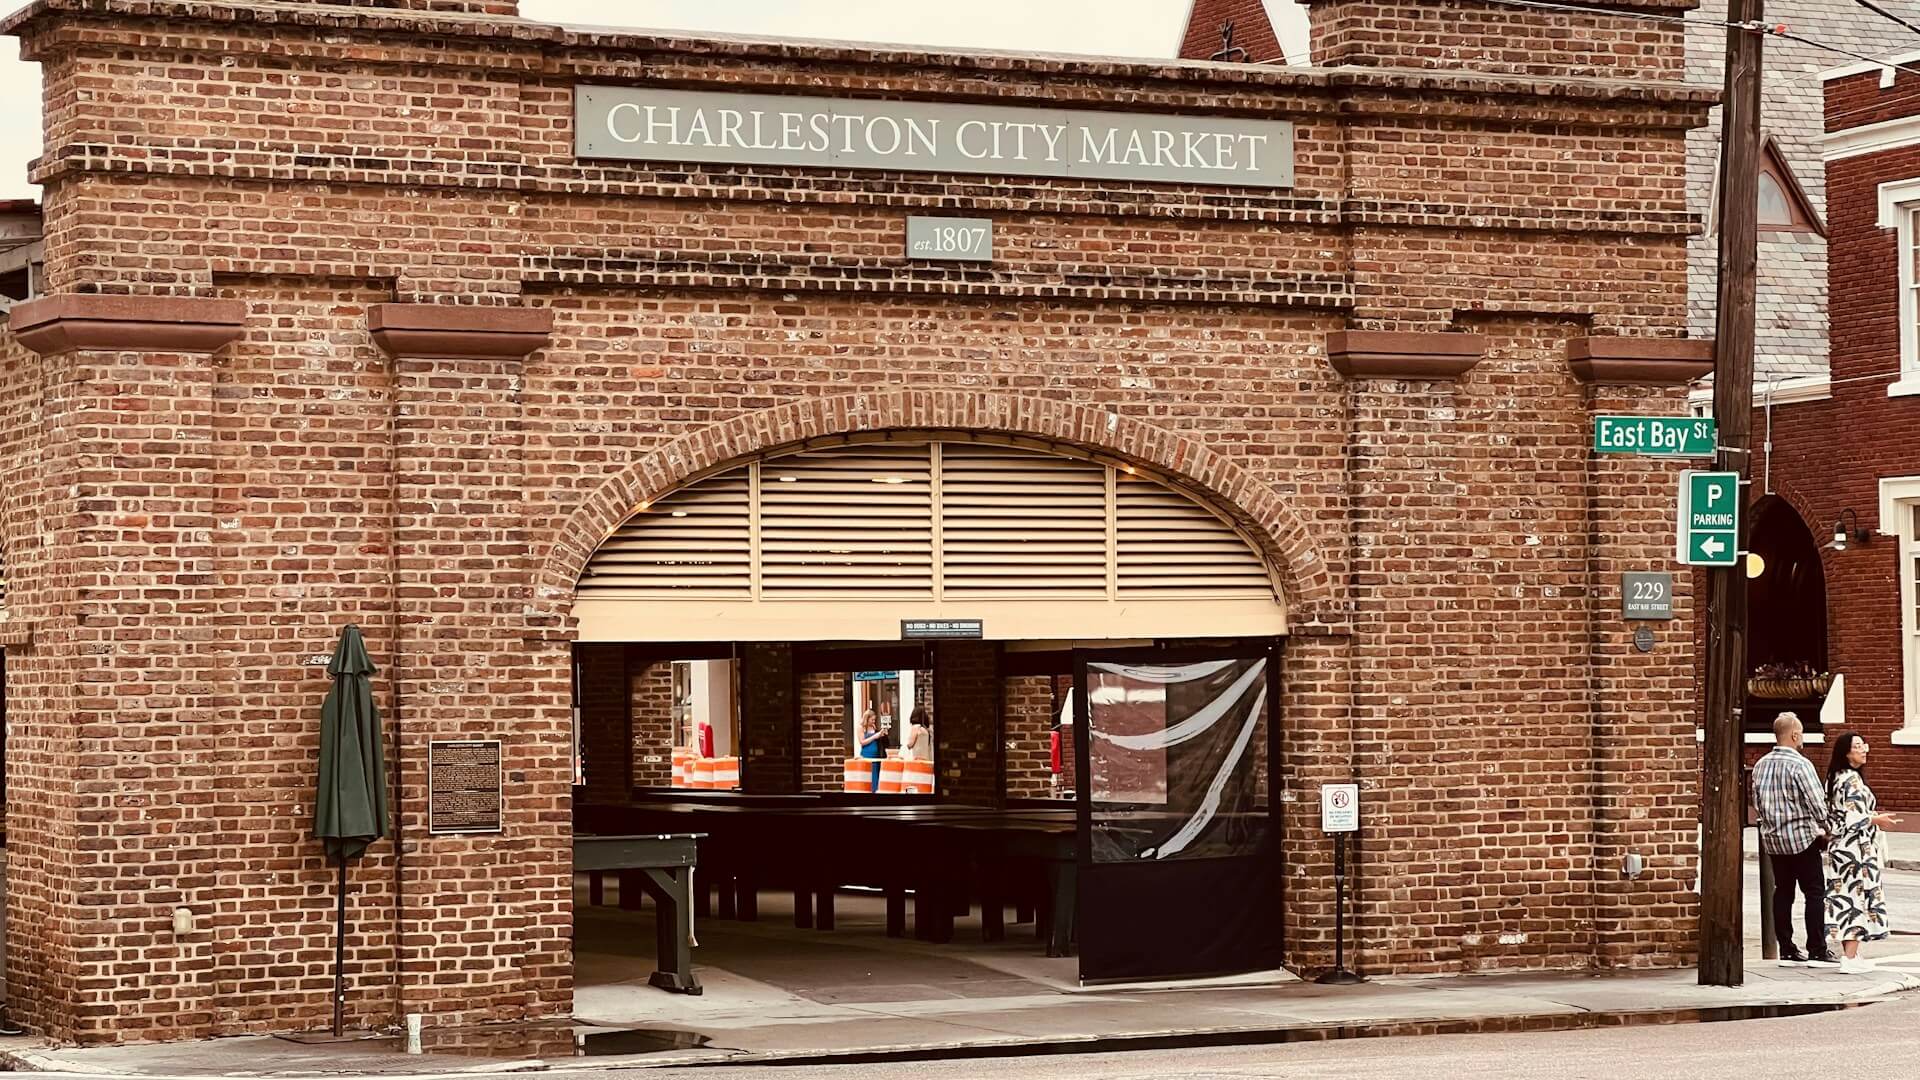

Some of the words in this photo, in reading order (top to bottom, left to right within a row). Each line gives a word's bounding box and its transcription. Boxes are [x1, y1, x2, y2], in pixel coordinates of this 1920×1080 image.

[607, 103, 940, 156] CHARLESTON
[956, 121, 1066, 162] CITY
[1079, 126, 1267, 171] MARKET
[933, 227, 986, 254] 1807
[1600, 421, 1645, 447] East
[1651, 421, 1689, 452] Bay
[1693, 422, 1708, 439] St
[1707, 484, 1723, 508] P
[1693, 513, 1733, 526] PARKING
[1633, 582, 1664, 601] 229
